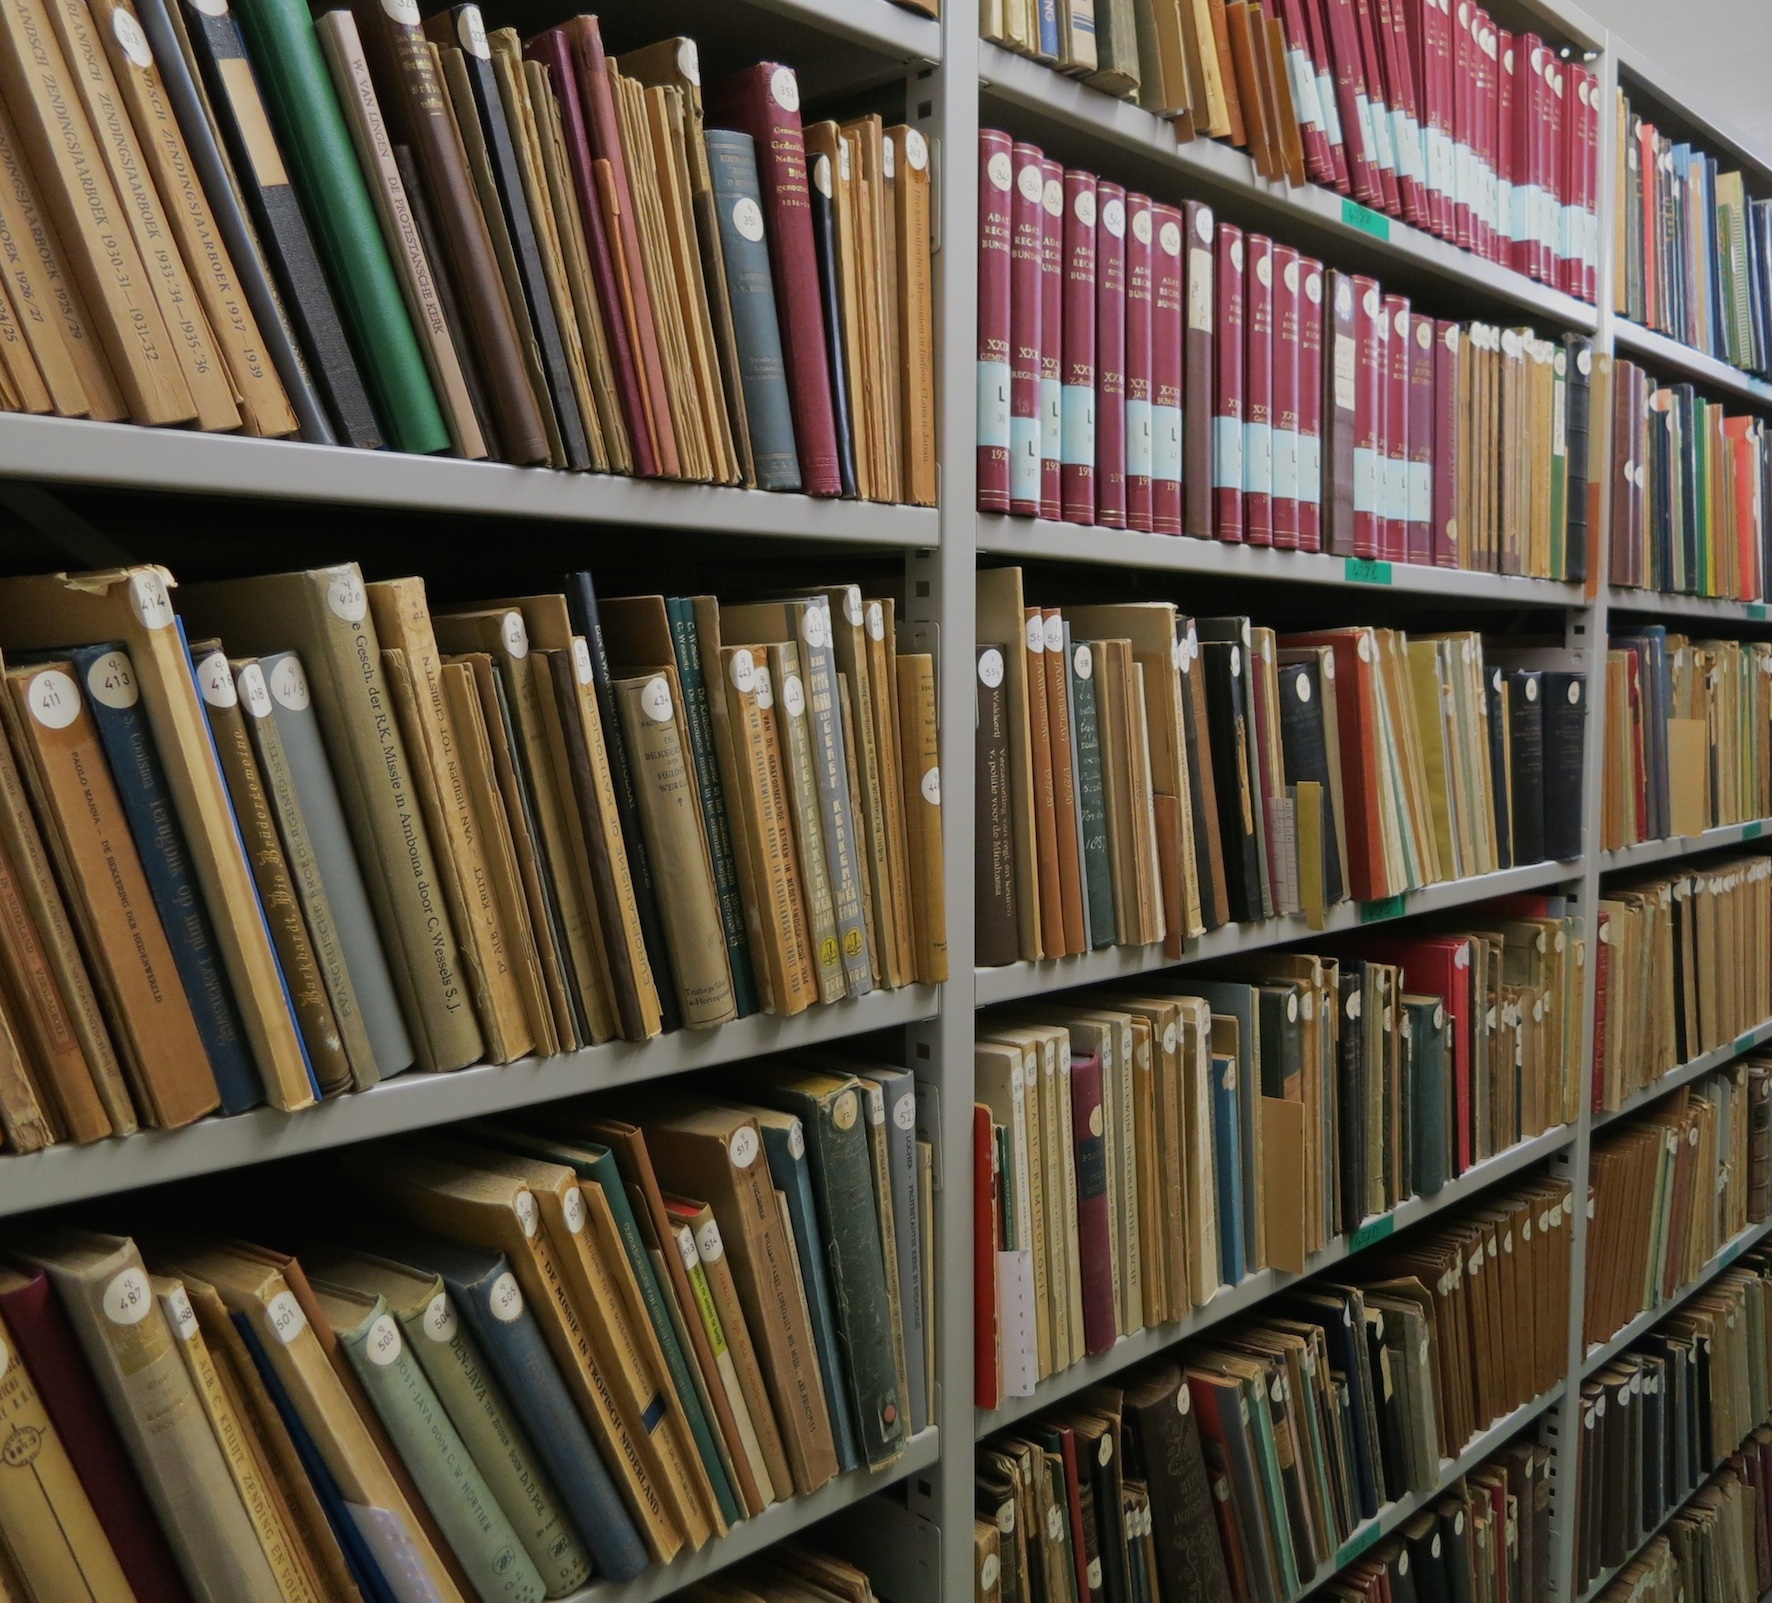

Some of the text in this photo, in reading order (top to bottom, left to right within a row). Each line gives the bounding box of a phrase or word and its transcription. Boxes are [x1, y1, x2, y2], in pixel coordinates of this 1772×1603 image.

[41, 73, 109, 226] ZENDINGSJAARBOEK
[97, 92, 161, 239] ZENDINGSJAARBOEK
[353, 59, 444, 335] W. VAN LINGEN DE PROTESTANSCHE KERK
[162, 129, 231, 292] ZENDINGSJAARBOEK
[15, 270, 44, 323] 1926/27
[54, 287, 82, 340] 1928/29
[998, 386, 1005, 402] L
[1053, 401, 1058, 417] L
[1088, 409, 1093, 424] L
[1144, 421, 1150, 437] L
[1172, 427, 1177, 442] L
[1028, 441, 1035, 457] L
[142, 594, 165, 611] 414
[356, 635, 376, 684] Gesch.
[739, 664, 752, 678] 443
[105, 673, 130, 690] 413
[211, 673, 233, 690] 416
[423, 655, 445, 722] CHRISTEN
[757, 684, 769, 696] 443
[42, 692, 61, 709] 411
[369, 687, 382, 711] der
[654, 694, 670, 707] 434
[375, 714, 392, 744] R.K.
[750, 713, 760, 731] VAN
[763, 715, 772, 732] VAN
[440, 728, 450, 756] TOT
[664, 736, 674, 745] DE
[754, 733, 762, 745] DE
[766, 737, 774, 749] DE
[383, 745, 401, 790] Missie
[448, 761, 467, 811] HEIDEN
[768, 754, 785, 822] GEREFORMEERDE
[234, 728, 283, 868] Brüdergemeine
[395, 793, 405, 808] in
[990, 796, 999, 823] voor
[461, 815, 474, 846] VAN
[609, 814, 619, 837] OF
[992, 824, 1001, 838] de
[1001, 817, 1009, 838] van
[399, 812, 424, 879] Amboina
[768, 826, 778, 860] KERKEN
[779, 826, 790, 860] KERKEN
[71, 751, 162, 1004] PAOLO MANNA DE BEKEERING DER HEIDENWERELD
[774, 863, 780, 874] IN
[784, 862, 792, 873] IN
[417, 882, 434, 915] door
[473, 866, 492, 911] KRUYT
[427, 917, 439, 933] C.
[616, 845, 650, 986] EUROPEANISME
[8, 893, 66, 1043] NEDERLAND VERSLAGBOEK
[313, 903, 351, 1018] EVANGELISCHE
[431, 930, 452, 988] Wessels
[445, 987, 458, 1002] S.
[736, 1140, 750, 1156] 517
[905, 1137, 914, 1170] LOCHER
[908, 1184, 918, 1248] PROTESTANTSE
[683, 1243, 695, 1259] 513
[704, 1236, 718, 1251] 514
[1130, 1242, 1138, 1287] RECHT
[119, 1287, 142, 1310] 487
[500, 1285, 518, 1307] 505
[764, 1231, 794, 1348] WILLIAM ESPECIALLY HIS
[177, 1307, 193, 1325] 488
[275, 1308, 297, 1331] 501
[377, 1330, 395, 1352] 503
[544, 1259, 660, 1516] DE MISSIE IN TROPISCH NEDERLAND
[431, 1425, 449, 1454] DOOR
[462, 1480, 492, 1534] NORTIER
[532, 1493, 543, 1516] POL
[243, 1474, 285, 1565] ZENDING EN
